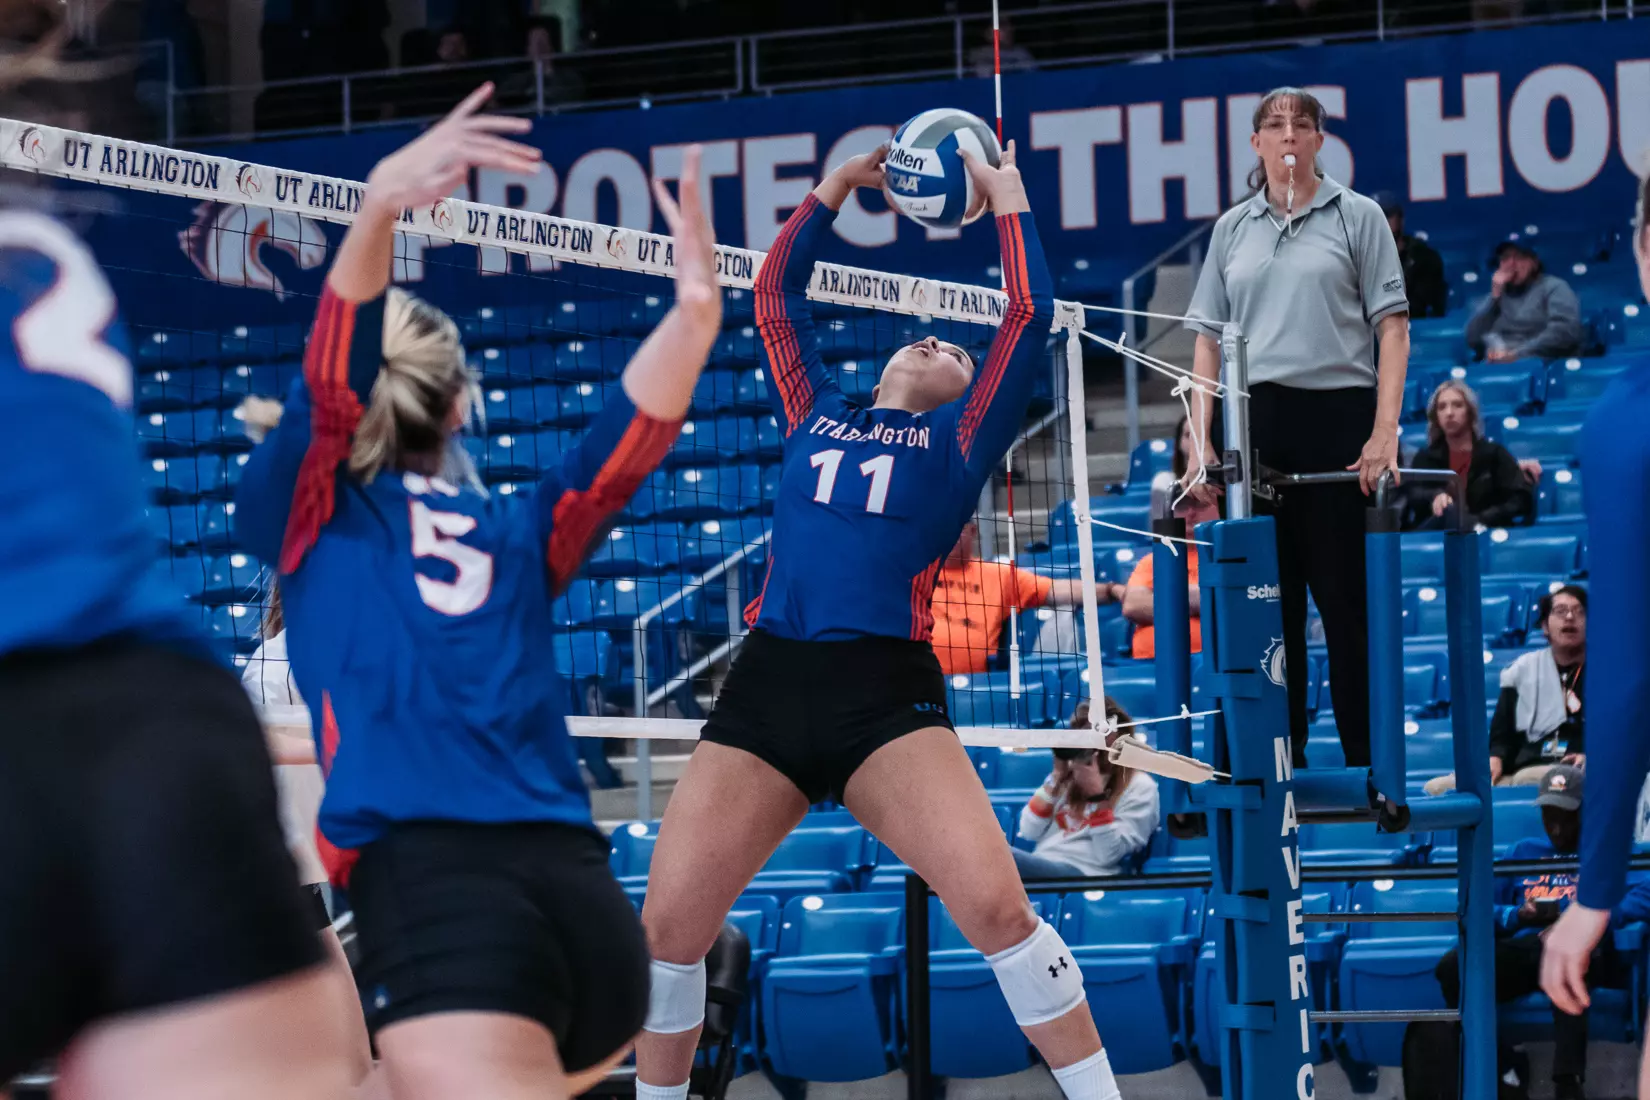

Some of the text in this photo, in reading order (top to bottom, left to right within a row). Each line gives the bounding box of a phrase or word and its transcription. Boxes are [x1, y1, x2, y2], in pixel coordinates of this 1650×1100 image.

[63, 137, 221, 191] UT ARLINGTON
[888, 147, 925, 172] olten
[274, 173, 303, 203] UT
[391, 117, 985, 283] ROTEC
[466, 209, 595, 254] UT ARLINGTON
[637, 236, 661, 264] UT
[818, 267, 901, 304] ARLINGTON
[938, 285, 957, 311] UT
[810, 448, 895, 514] 11
[407, 498, 495, 617] 5
[1273, 736, 1316, 1100] MAVERIC
